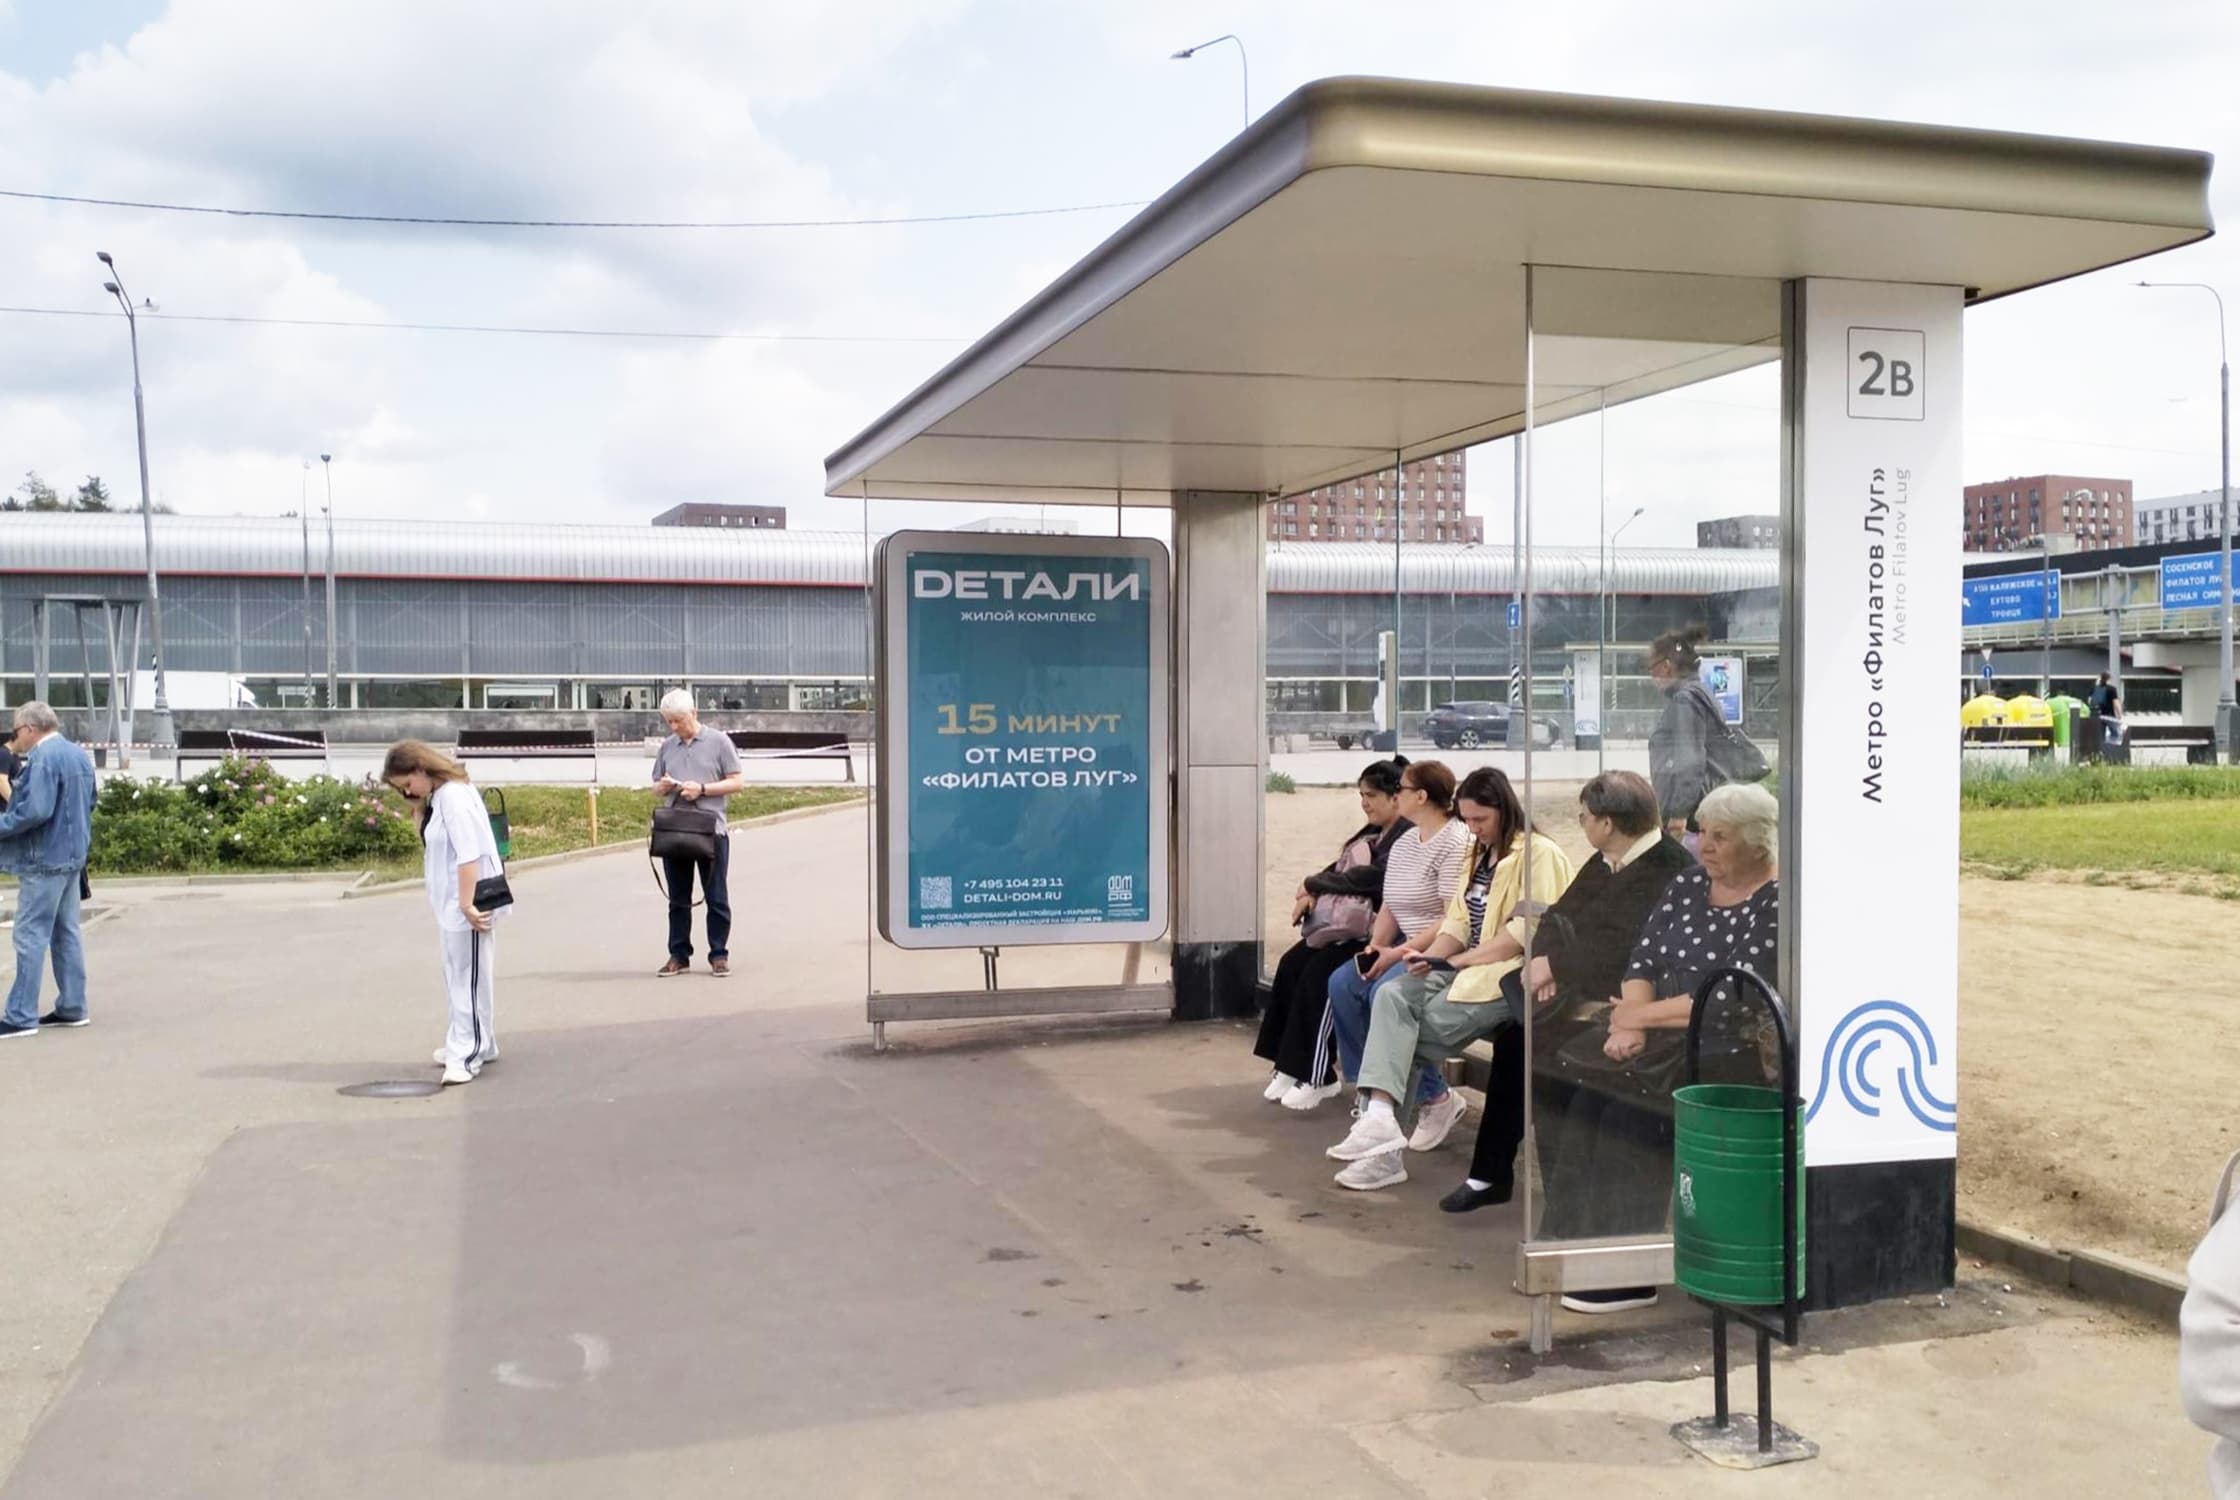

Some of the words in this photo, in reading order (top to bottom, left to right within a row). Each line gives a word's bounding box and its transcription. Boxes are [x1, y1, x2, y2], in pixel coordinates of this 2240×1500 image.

[1864, 467, 1890, 537] Луг»
[1893, 466, 1911, 506] Lug
[1892, 511, 1907, 577] Filatov
[961, 609, 1014, 622] ЖИЛОЙ
[1018, 611, 1097, 623] КОМПЛЕКС
[1862, 544, 1885, 691] «Филатов
[1892, 582, 1907, 646] Metro
[937, 703, 998, 735] 15
[1008, 714, 1121, 734] МИНУТ
[965, 748, 1000, 764] ОТ
[1007, 747, 1097, 764] МЕТРО
[1862, 701, 1888, 804] Метро
[922, 772, 1068, 789] «ФИЛАТОВ
[1073, 770, 1138, 787] ЛУГ»
[963, 891, 1062, 904] DETALI-DOM.RU
[978, 879, 1003, 889] 495
[1005, 878, 1029, 888] 104
[1031, 877, 1047, 887] 23
[1048, 877, 1064, 887] 11
